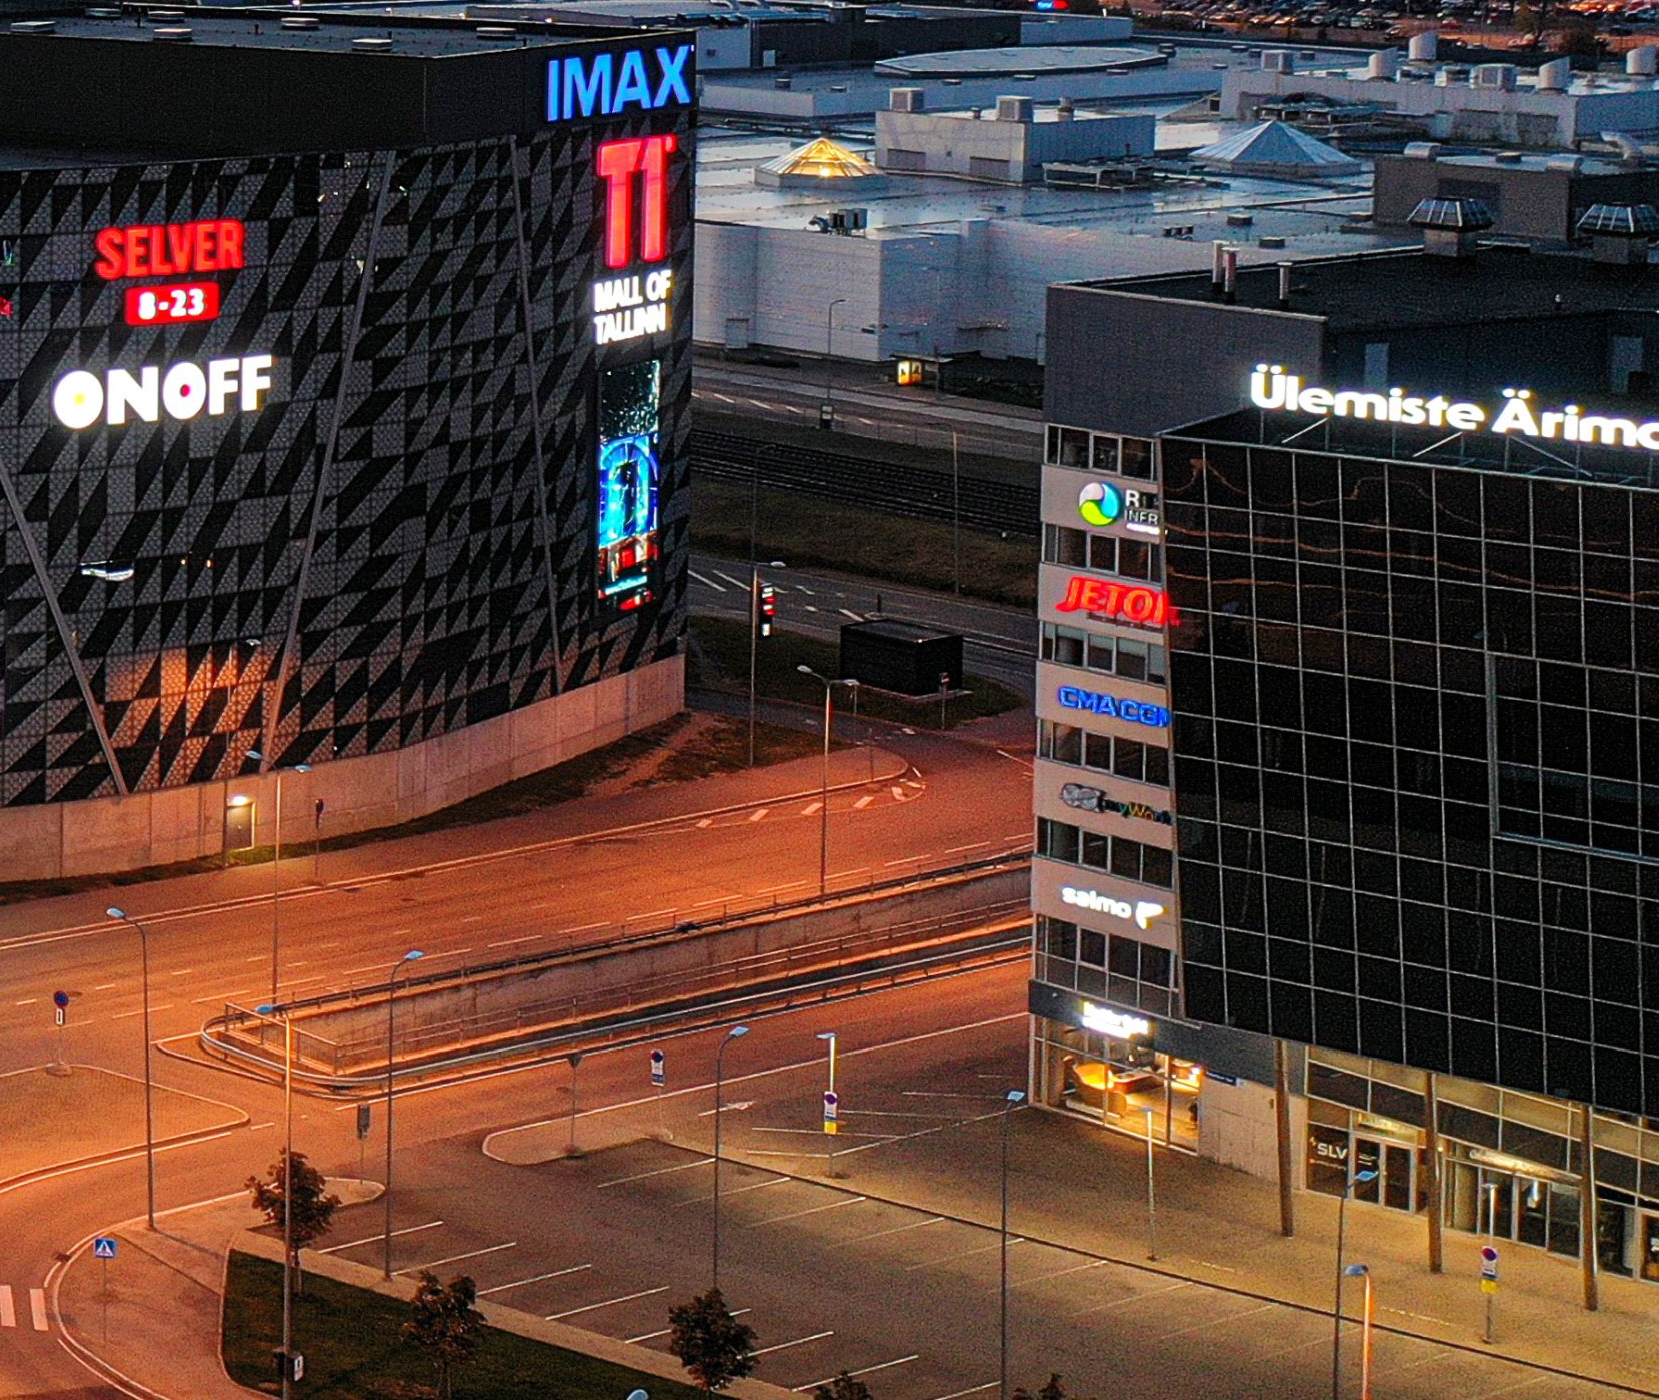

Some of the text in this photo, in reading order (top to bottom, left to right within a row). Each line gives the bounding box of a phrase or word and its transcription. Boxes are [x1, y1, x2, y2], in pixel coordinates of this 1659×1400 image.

[547, 45, 690, 122] IMAX
[597, 136, 669, 268] T1
[94, 219, 244, 281] SELVER
[138, 288, 204, 320] 8-23
[594, 270, 671, 312] MALL OF
[594, 302, 666, 345] TALLINN
[53, 355, 271, 429] ONOFF
[1250, 363, 1485, 431] Ülemiste
[1125, 509, 1158, 526] INFR
[1059, 686, 1116, 717] CMA
[1317, 1143, 1347, 1160] SLV
